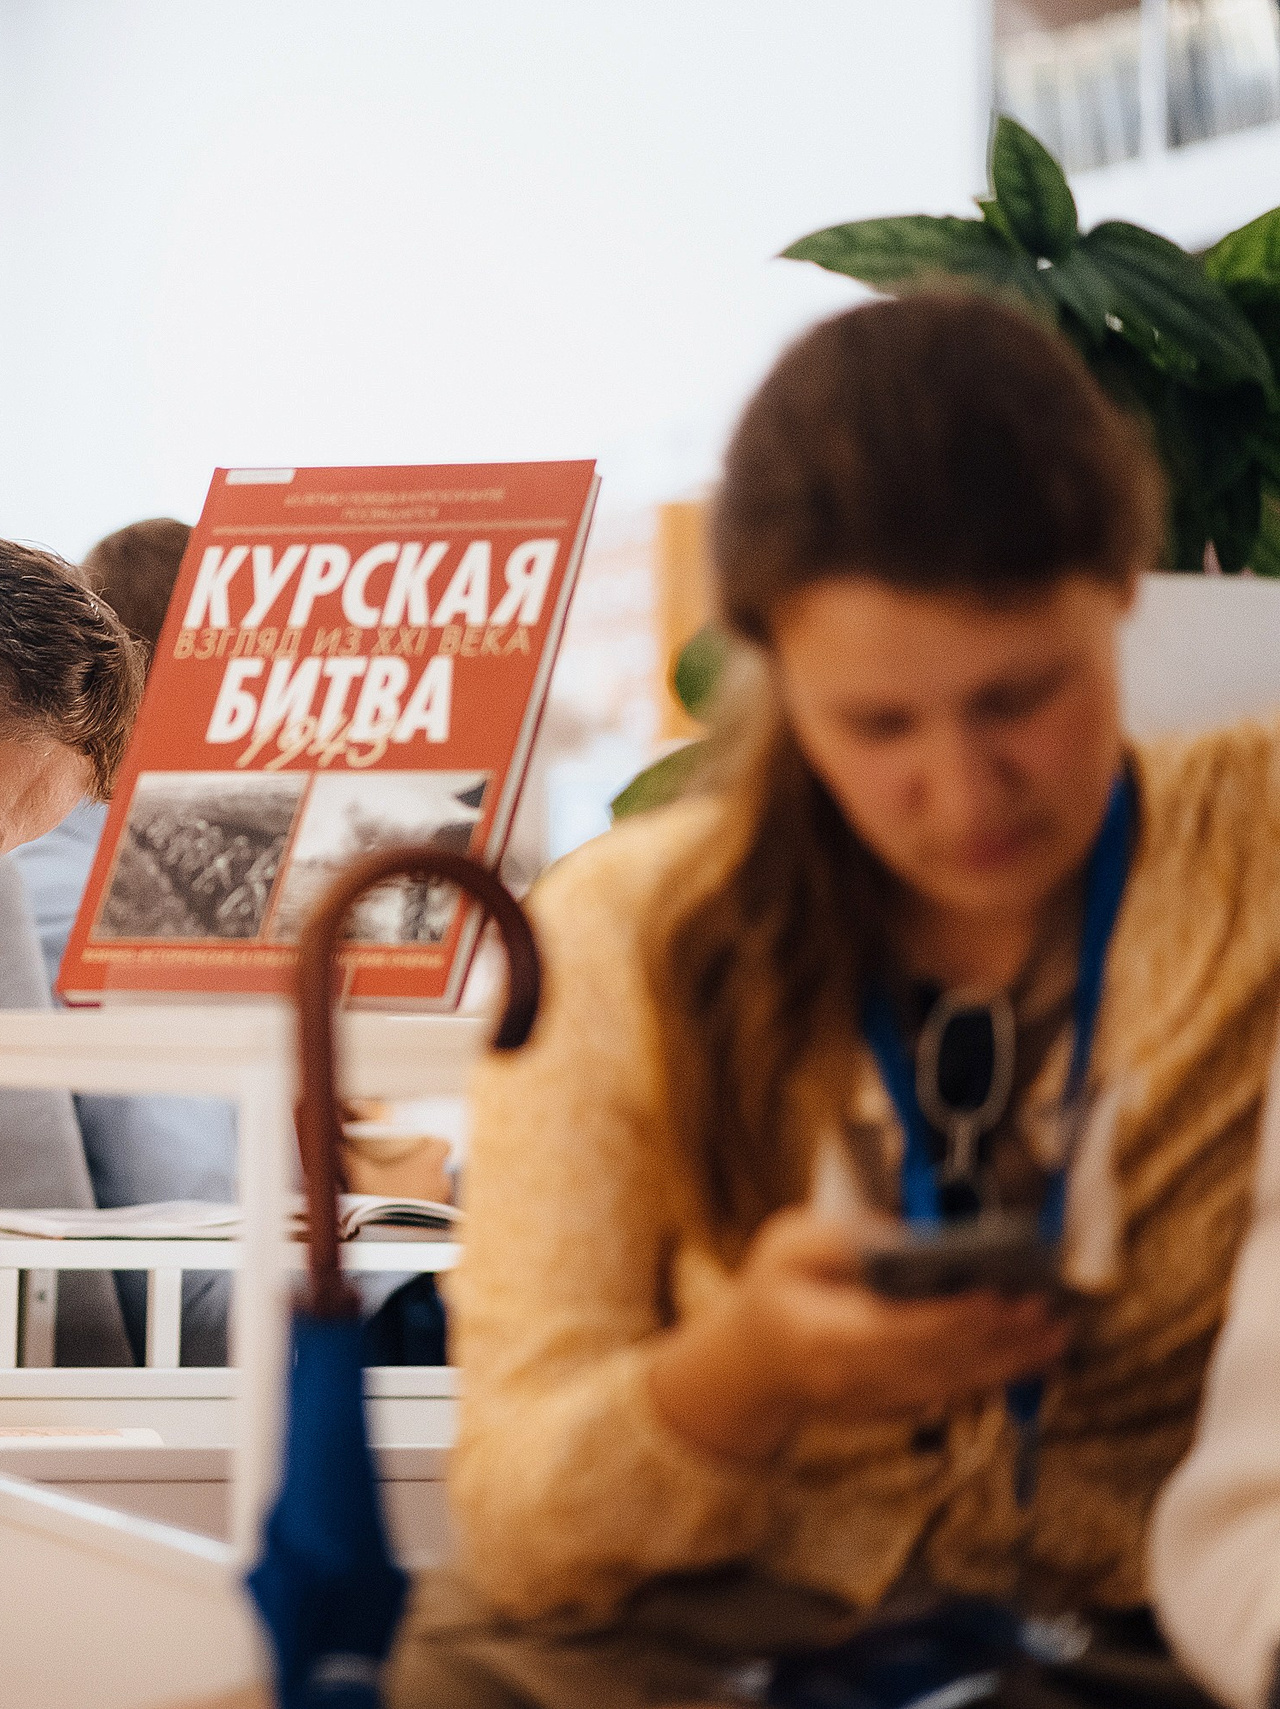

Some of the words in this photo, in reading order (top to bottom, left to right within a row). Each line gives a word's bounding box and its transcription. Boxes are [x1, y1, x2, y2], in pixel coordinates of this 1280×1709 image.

[184, 539, 561, 629] КУРСКАЯ
[173, 627, 303, 660] ВЗГЛЯД
[312, 627, 361, 657] ИЗ
[436, 625, 533, 656] ВЕКА
[205, 657, 454, 744] БИТВА
[235, 712, 397, 770] 1943
